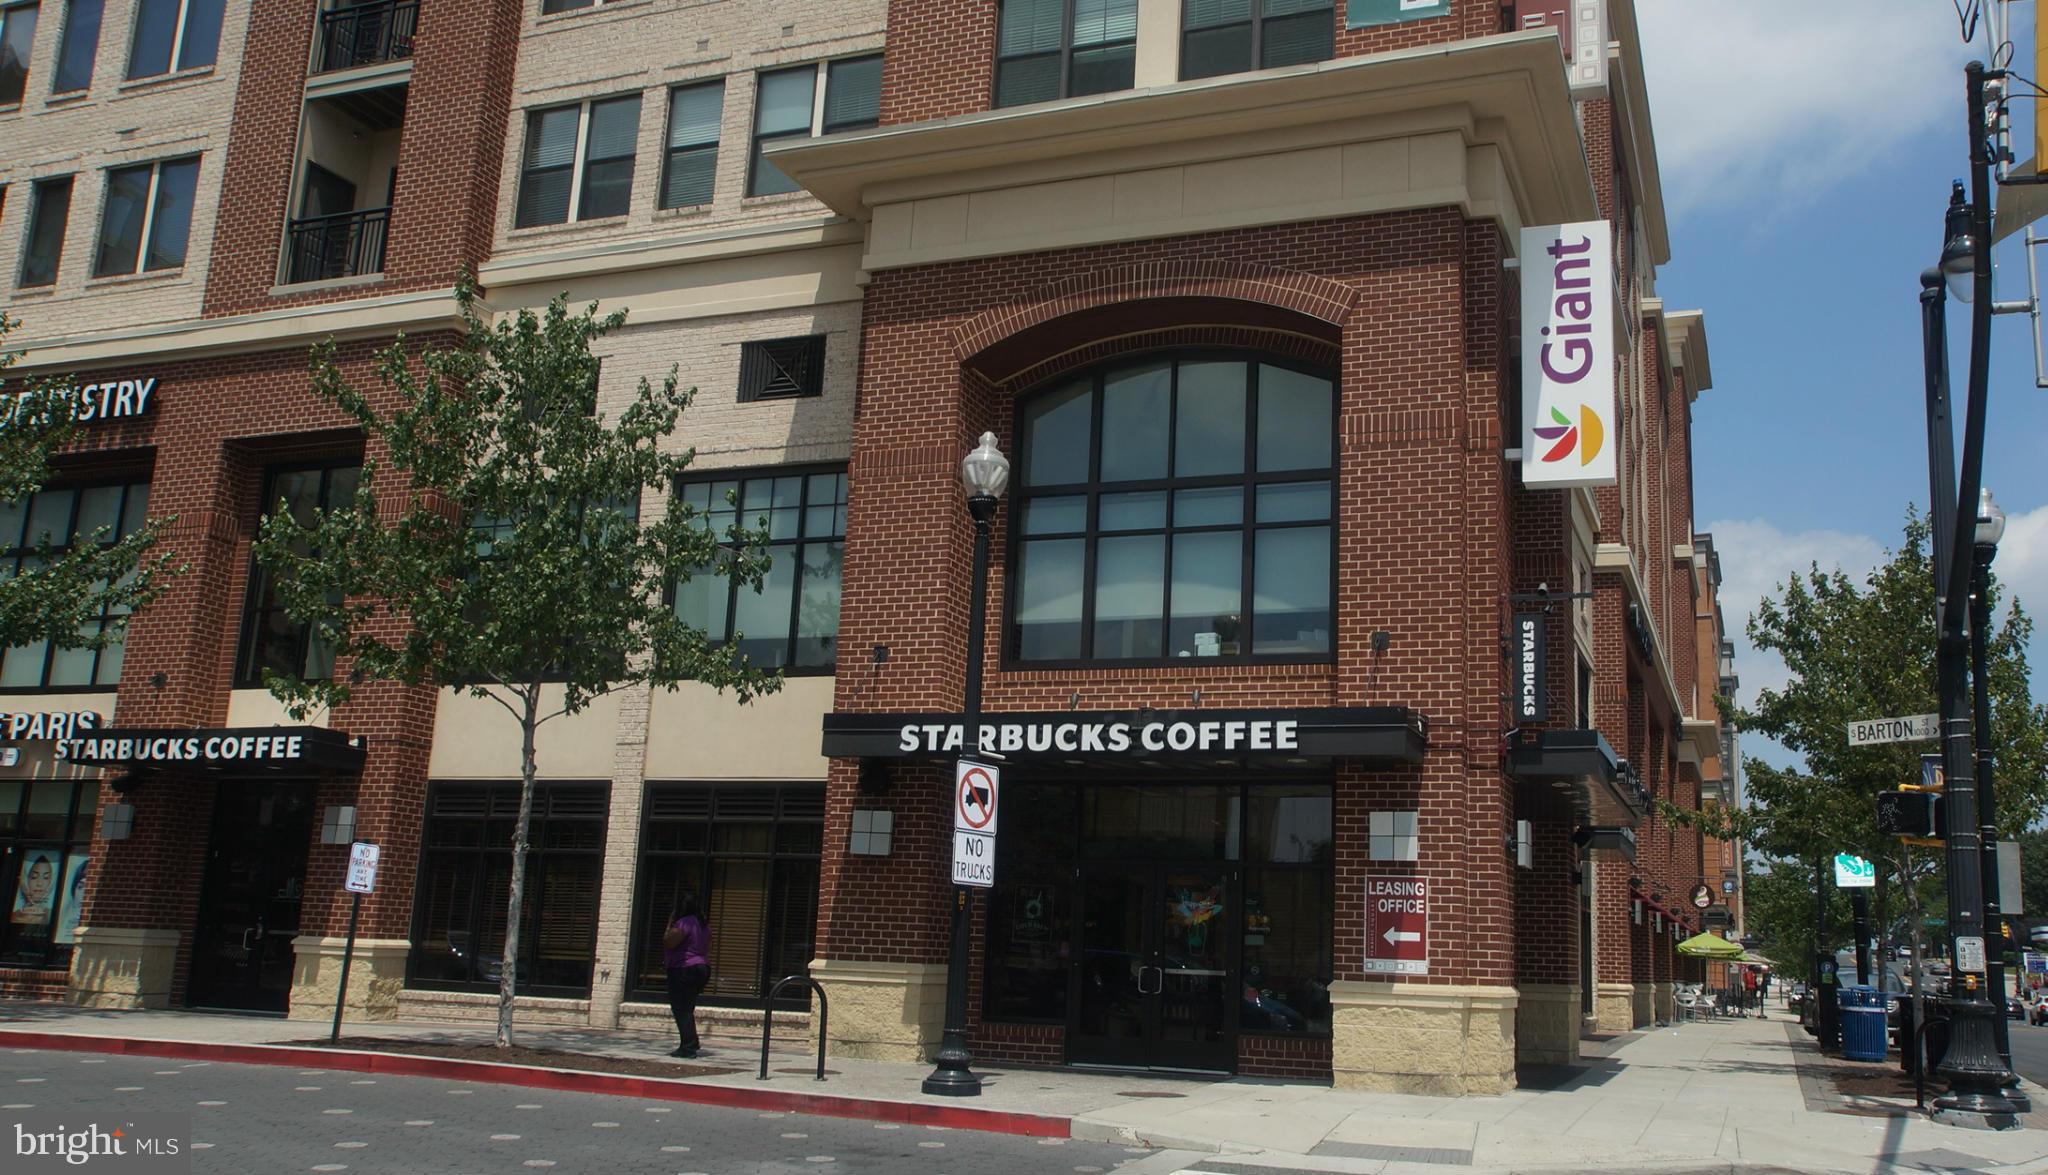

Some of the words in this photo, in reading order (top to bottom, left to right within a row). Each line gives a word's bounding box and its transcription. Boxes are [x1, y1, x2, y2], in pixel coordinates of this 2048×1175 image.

[1540, 234, 1593, 384] Giant
[0, 378, 155, 428] DEISTRY
[1522, 620, 1536, 717] STARBUCKS
[10, 710, 95, 740] PARIS
[899, 723, 1131, 752] STARBUCKS
[1141, 720, 1298, 751] COFFEE
[1851, 729, 1857, 738] S
[1857, 720, 1913, 741] BARTON
[54, 737, 199, 760] STARBUCKS
[204, 736, 302, 760] COFFEE
[360, 847, 371, 858] NO
[965, 836, 984, 857] NO
[955, 861, 992, 881] TRUCKS
[1368, 881, 1425, 896] LEASING
[1378, 899, 1425, 913] OFFICE
